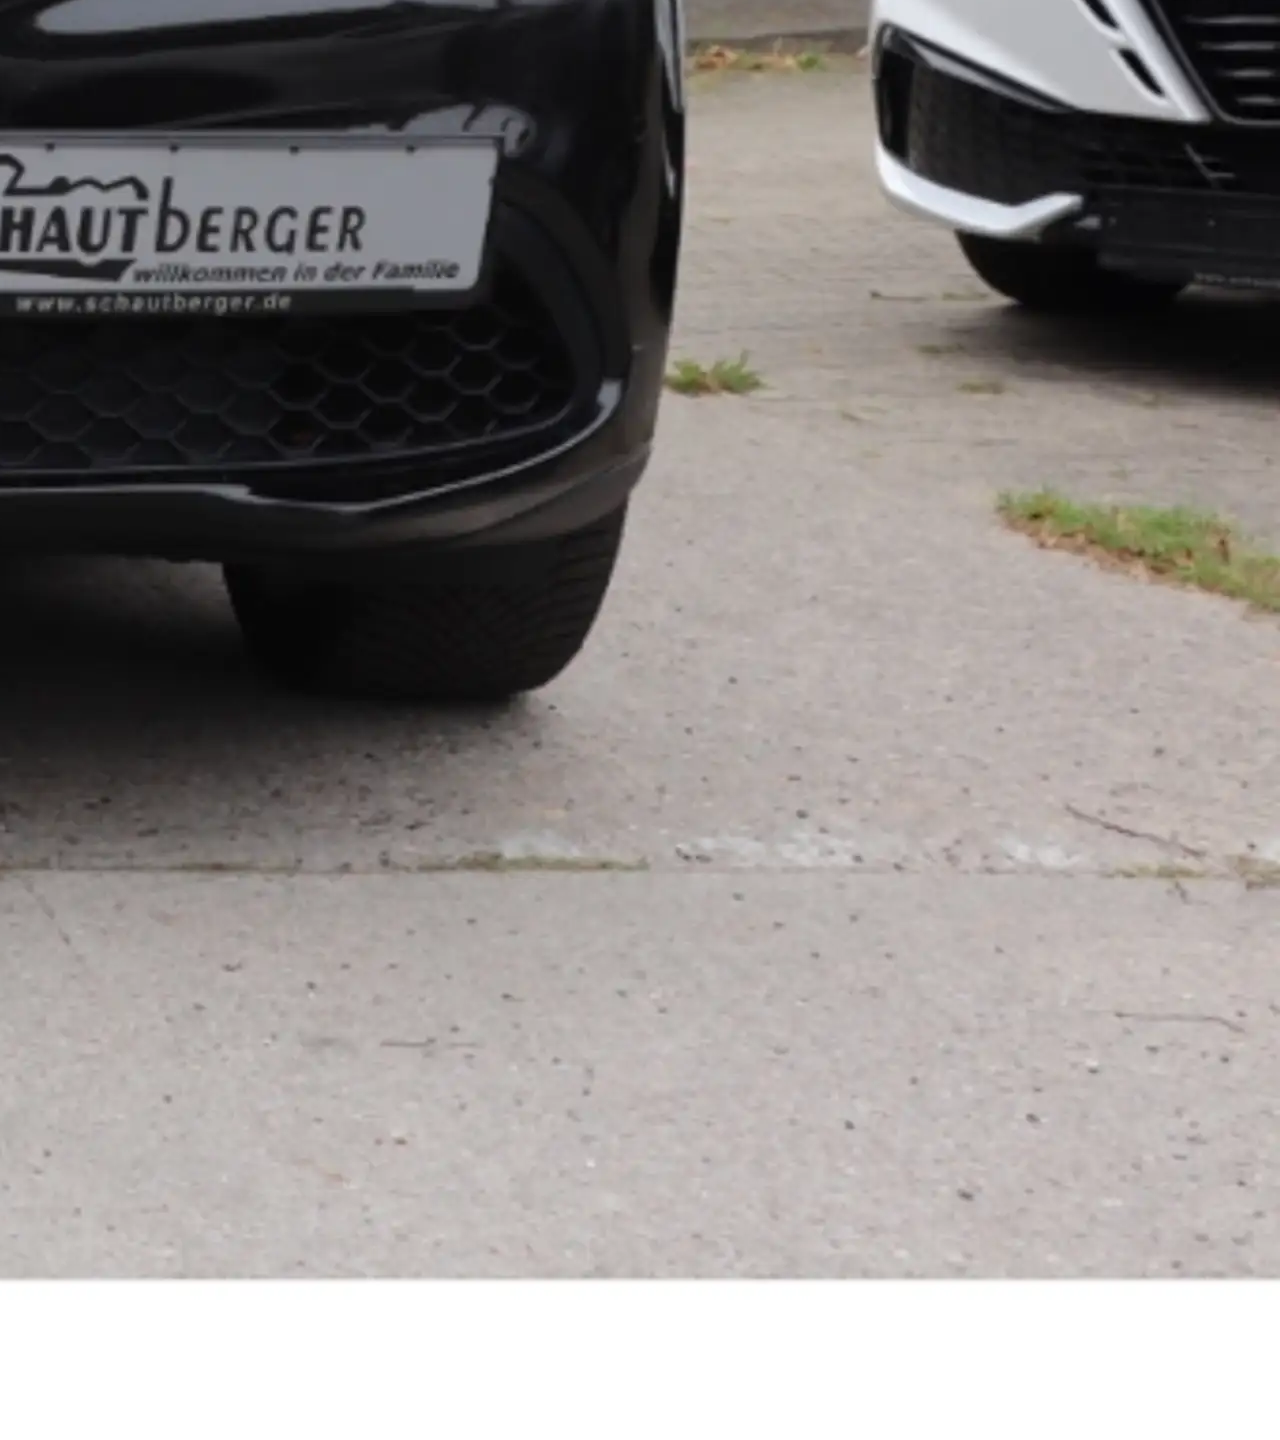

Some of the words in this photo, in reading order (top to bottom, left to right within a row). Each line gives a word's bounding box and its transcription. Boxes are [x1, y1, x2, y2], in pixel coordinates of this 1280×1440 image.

[133, 260, 285, 283] willkommen
[294, 261, 316, 282] in
[324, 261, 365, 282] der
[372, 261, 461, 282] Familie
[15, 293, 292, 315] www.schautberger.de
